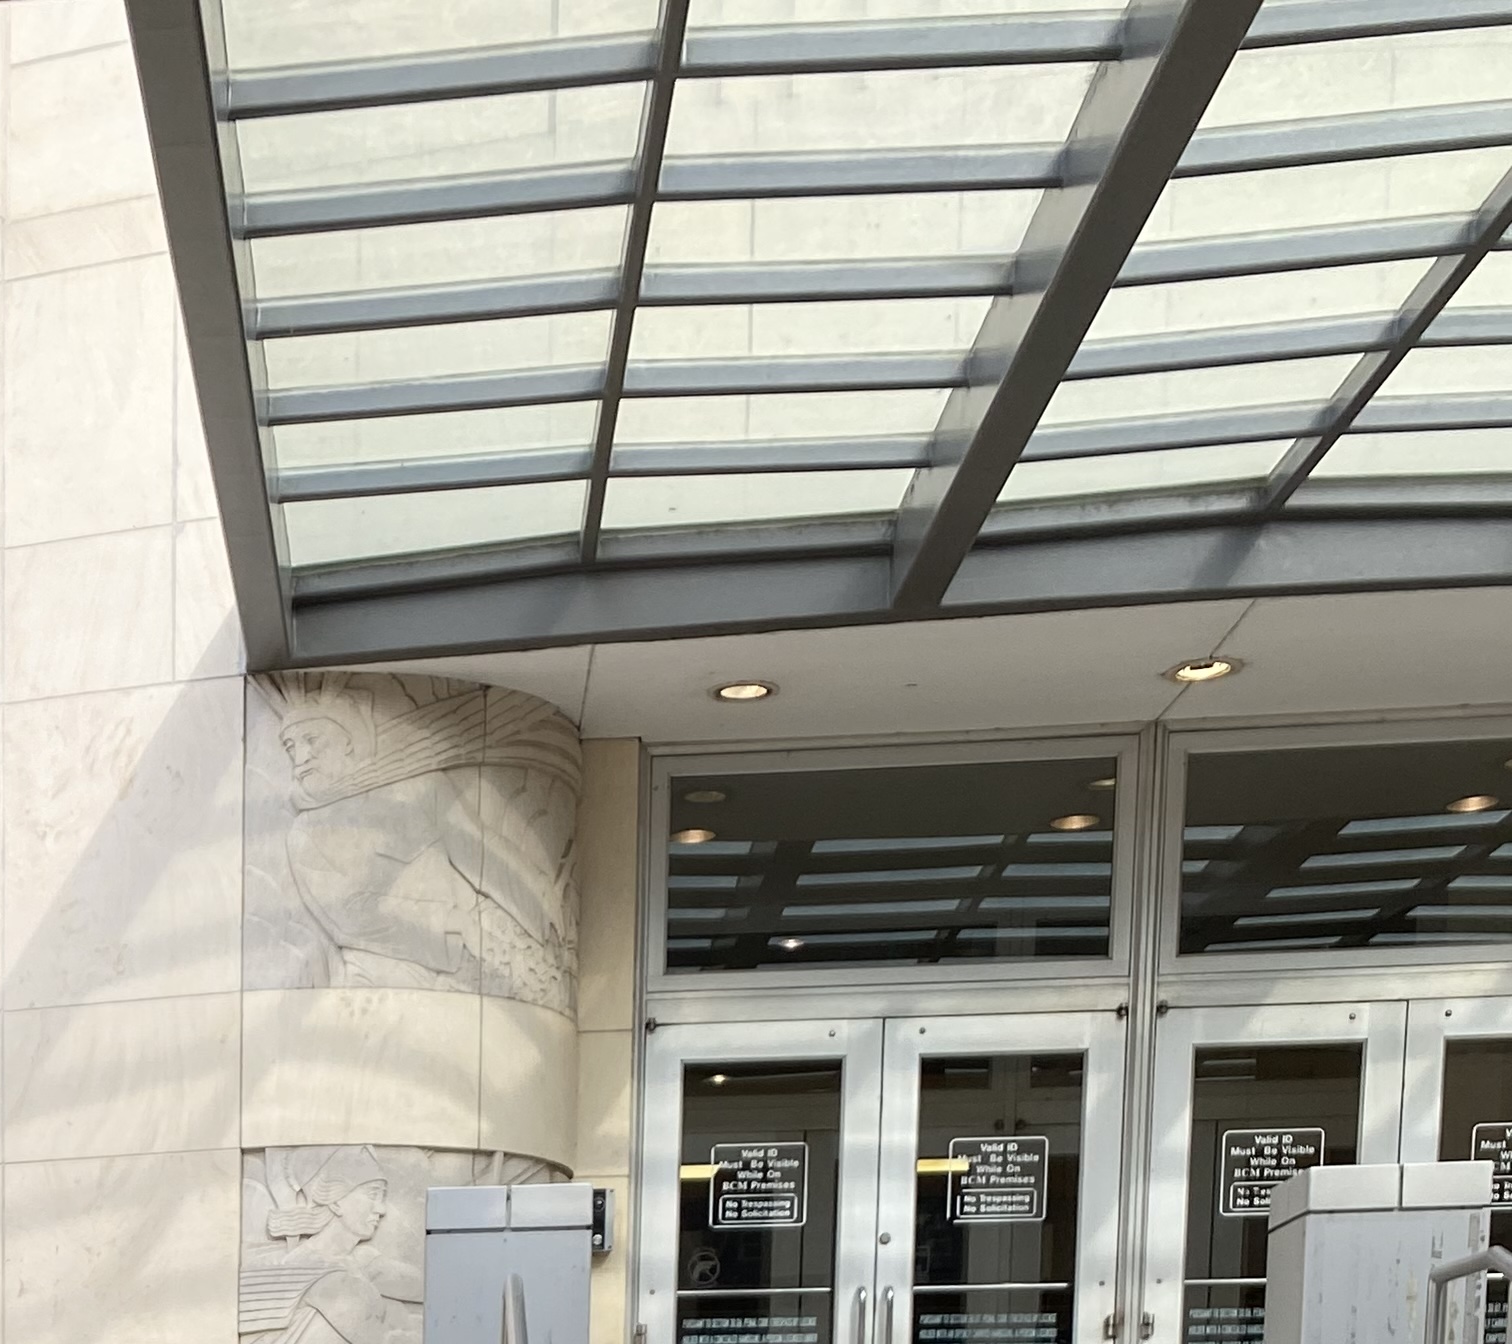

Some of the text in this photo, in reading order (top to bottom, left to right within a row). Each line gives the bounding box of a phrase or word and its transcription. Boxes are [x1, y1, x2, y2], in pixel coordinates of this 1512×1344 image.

[1255, 1134, 1293, 1144] Valid ID
[980, 1142, 1018, 1152] Valid ID
[1230, 1145, 1315, 1156] Must Be Visible
[741, 1148, 778, 1157] Valid ID
[989, 1153, 1003, 1162] Be
[1007, 1153, 1039, 1162] Visible
[1250, 1156, 1296, 1166] While On
[719, 1159, 799, 1169] Must Be Visible
[976, 1163, 1021, 1173] While On
[737, 1169, 781, 1179] While On
[1233, 1168, 1260, 1177] BCM
[989, 1175, 1035, 1184] Premises
[722, 1181, 795, 1190] BCM Premises
[725, 1200, 791, 1208] No Trespassing
[979, 1204, 1029, 1213] Solicitation
[725, 1209, 791, 1218] No Solicitation
